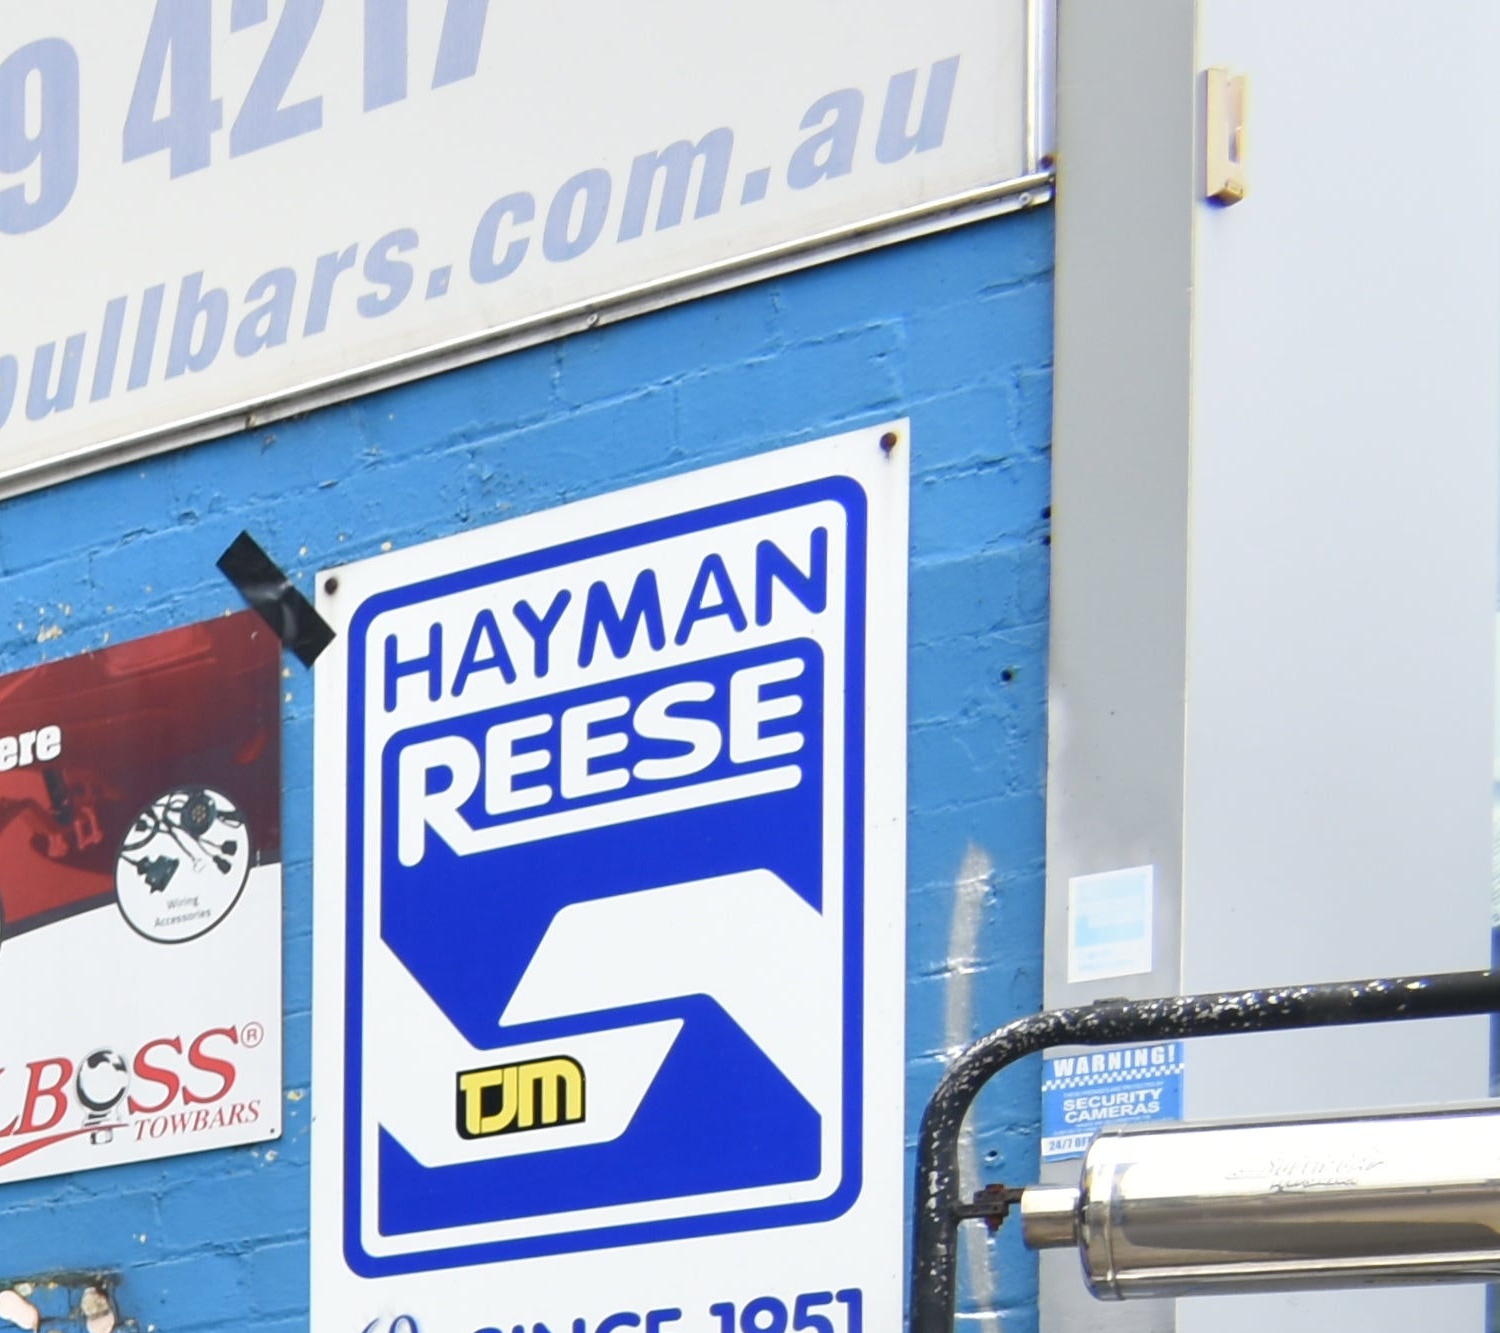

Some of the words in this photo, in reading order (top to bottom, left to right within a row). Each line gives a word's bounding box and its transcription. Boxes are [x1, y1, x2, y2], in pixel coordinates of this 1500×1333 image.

[383, 525, 829, 713] HAYMAN
[397, 655, 807, 866] REESE
[1053, 1044, 1177, 1078] WARNING!
[459, 1056, 584, 1133] TJM
[1063, 1087, 1164, 1113] SECURITY
[1064, 1101, 1161, 1125] CAMERAS
[133, 1099, 261, 1142] TOWBARS
